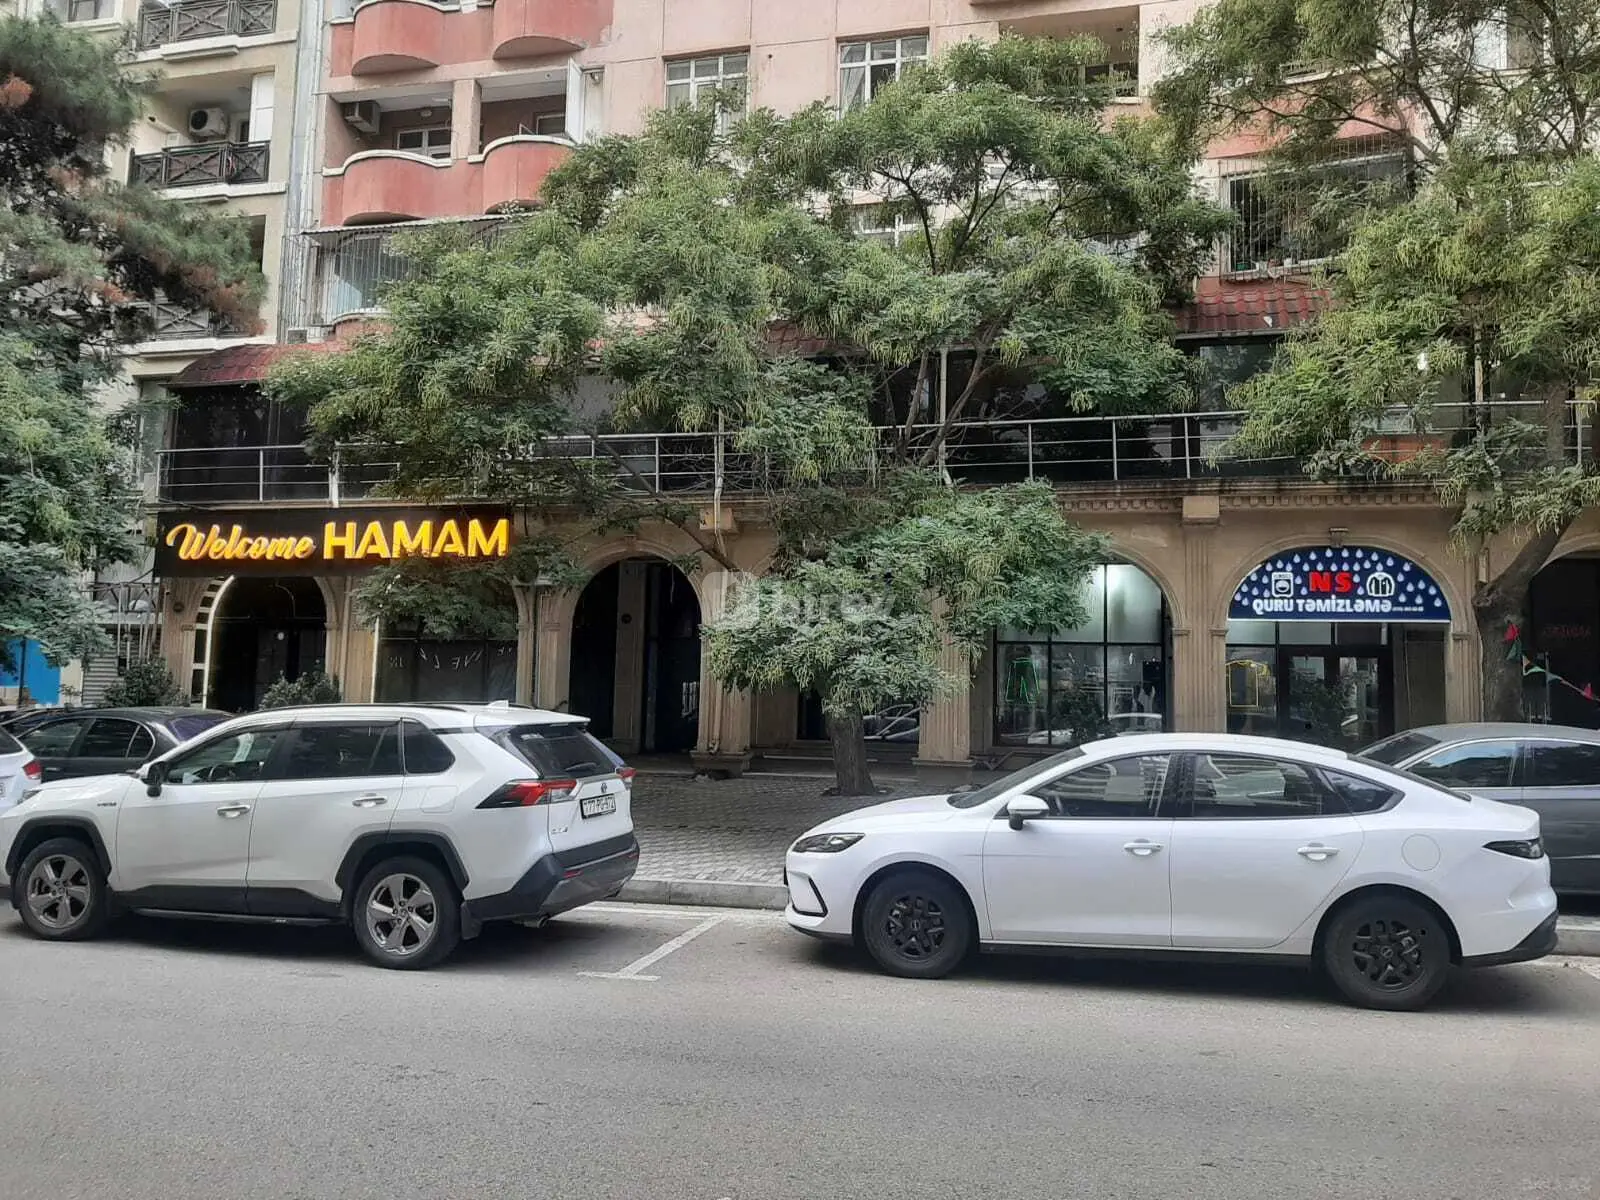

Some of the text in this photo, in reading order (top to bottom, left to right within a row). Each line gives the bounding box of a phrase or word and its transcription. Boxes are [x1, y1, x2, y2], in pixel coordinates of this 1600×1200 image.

[165, 518, 509, 561] Welcome HAMAM
[1252, 594, 1392, 615] QURU TƏMİZLƏMƏ
